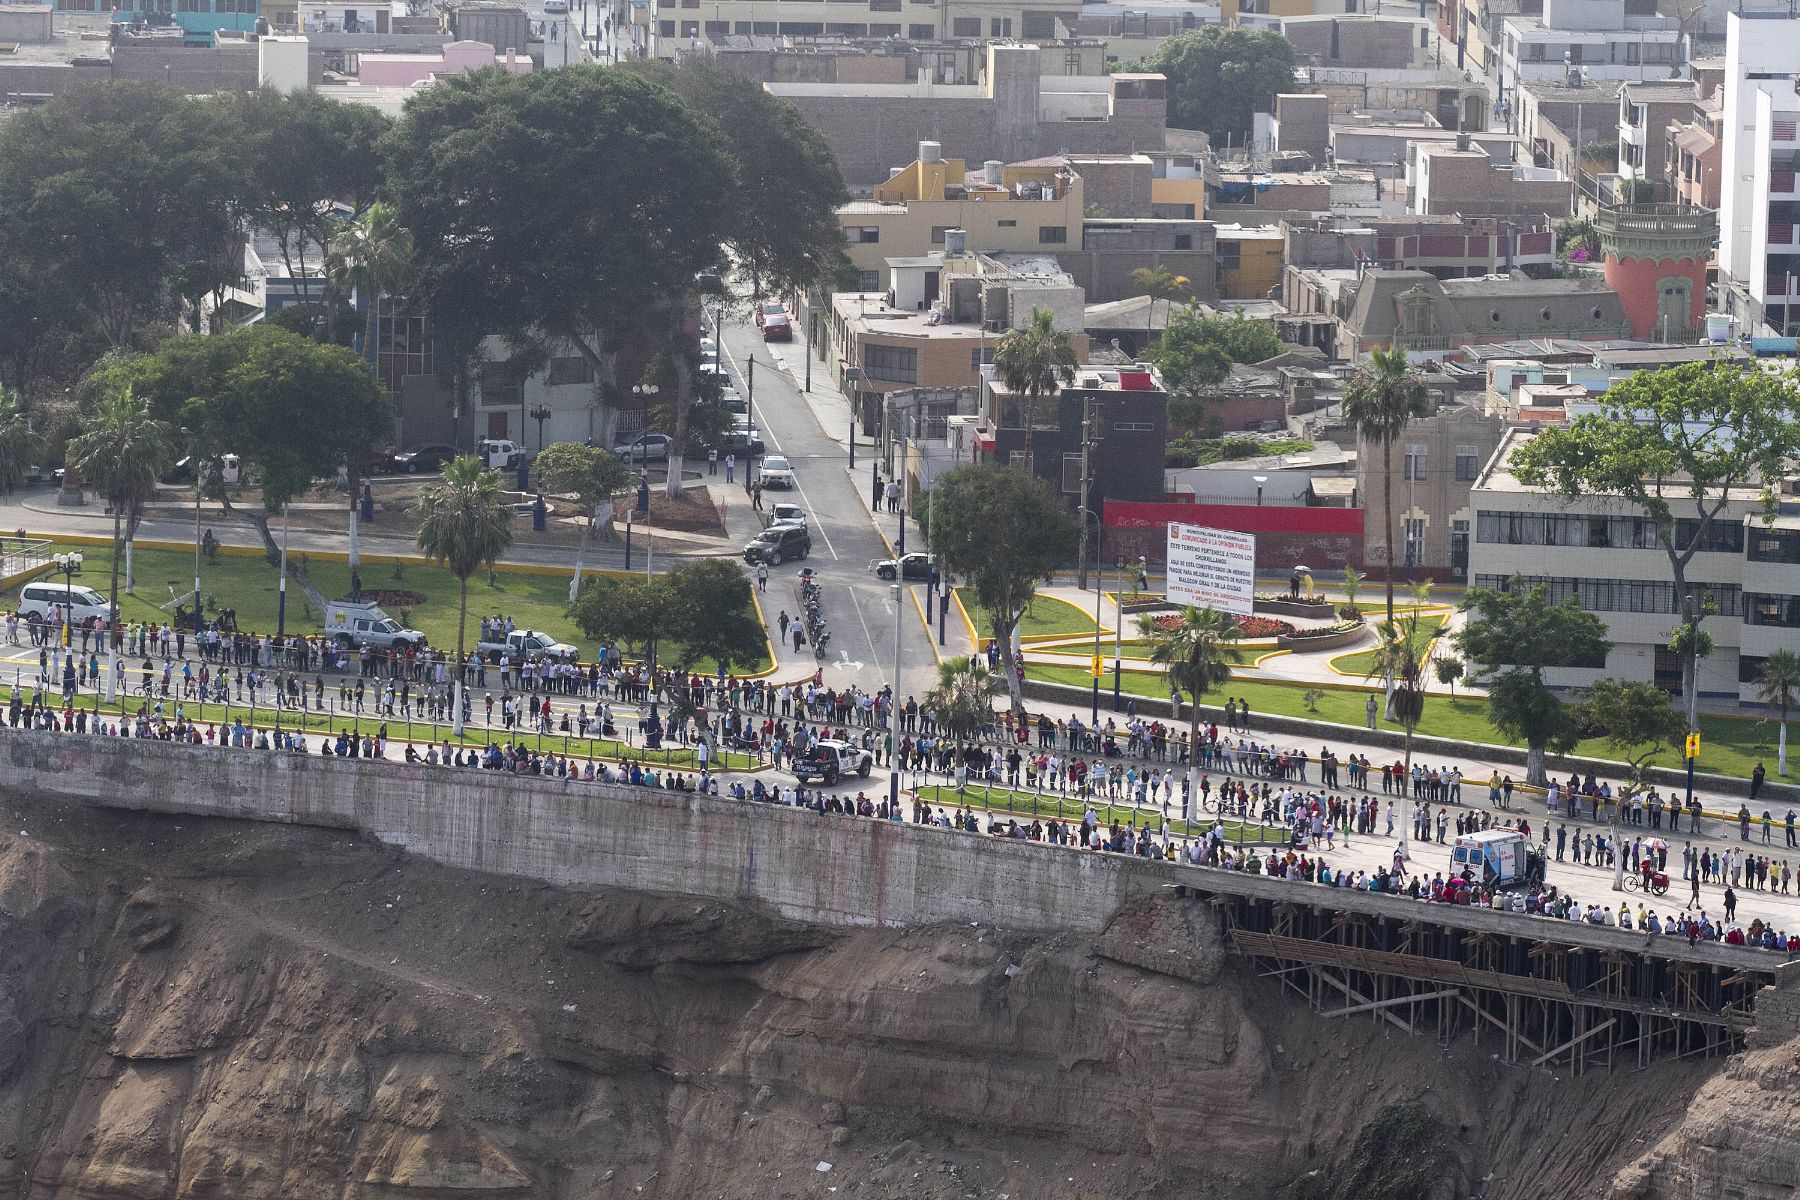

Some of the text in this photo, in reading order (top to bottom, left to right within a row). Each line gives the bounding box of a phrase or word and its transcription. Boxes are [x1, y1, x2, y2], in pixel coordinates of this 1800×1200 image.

[1186, 529, 1216, 538] MUNICIPALIDAD
[1182, 535, 1207, 544] COMUNICADO
[1201, 548, 1224, 556] PERTENECE
[1195, 555, 1226, 564] CHORRILLANOS
[1196, 564, 1225, 572] CONSTRUYENDO
[1196, 596, 1228, 605] DELINCUENTES
[1220, 594, 1250, 603] DROGADICTOS
